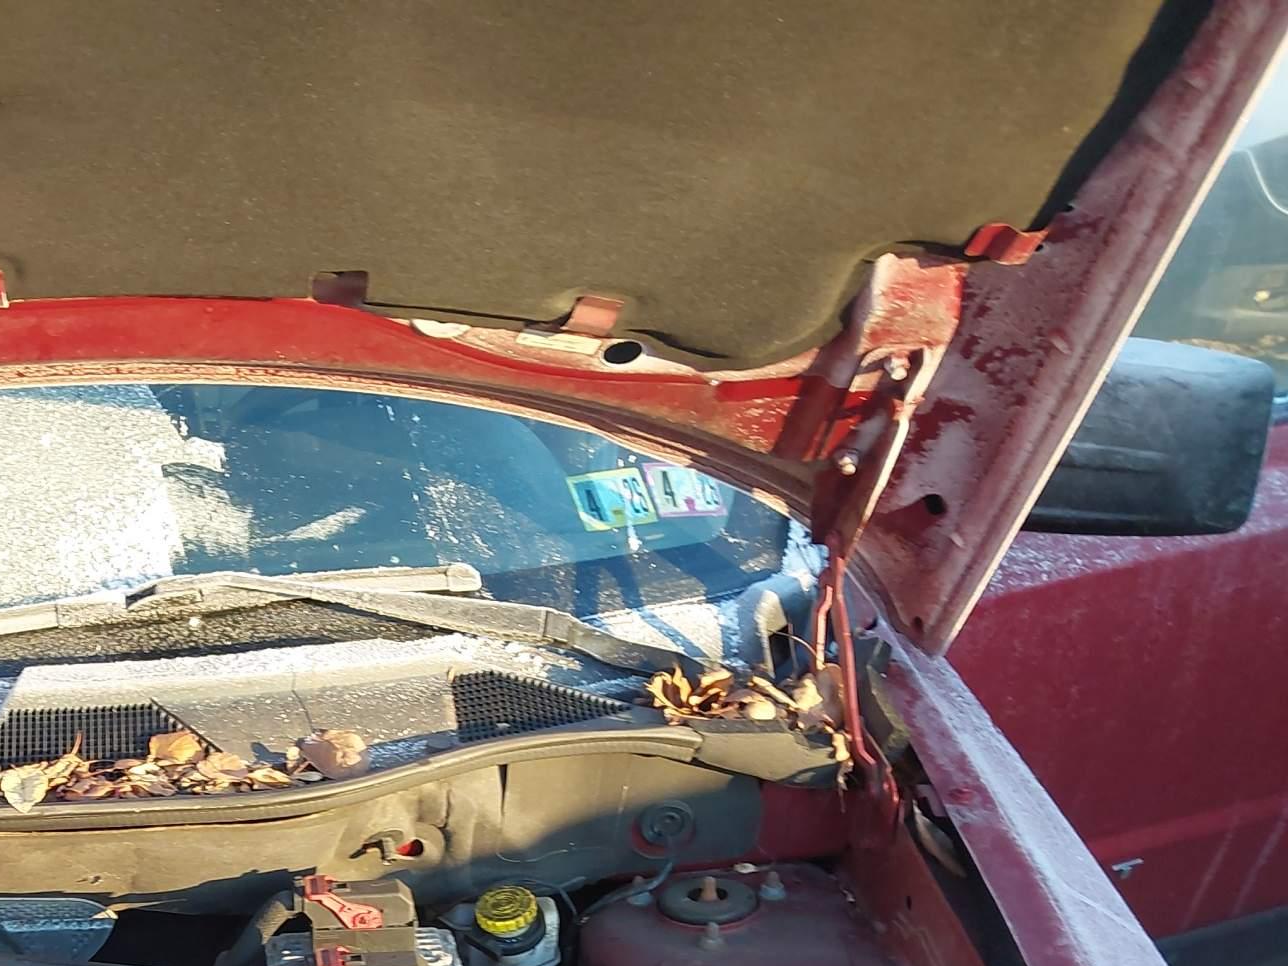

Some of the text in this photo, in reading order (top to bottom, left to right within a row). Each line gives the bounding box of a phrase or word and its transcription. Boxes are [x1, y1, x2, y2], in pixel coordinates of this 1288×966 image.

[584, 476, 649, 522] 4 25
[661, 470, 678, 508] 4
